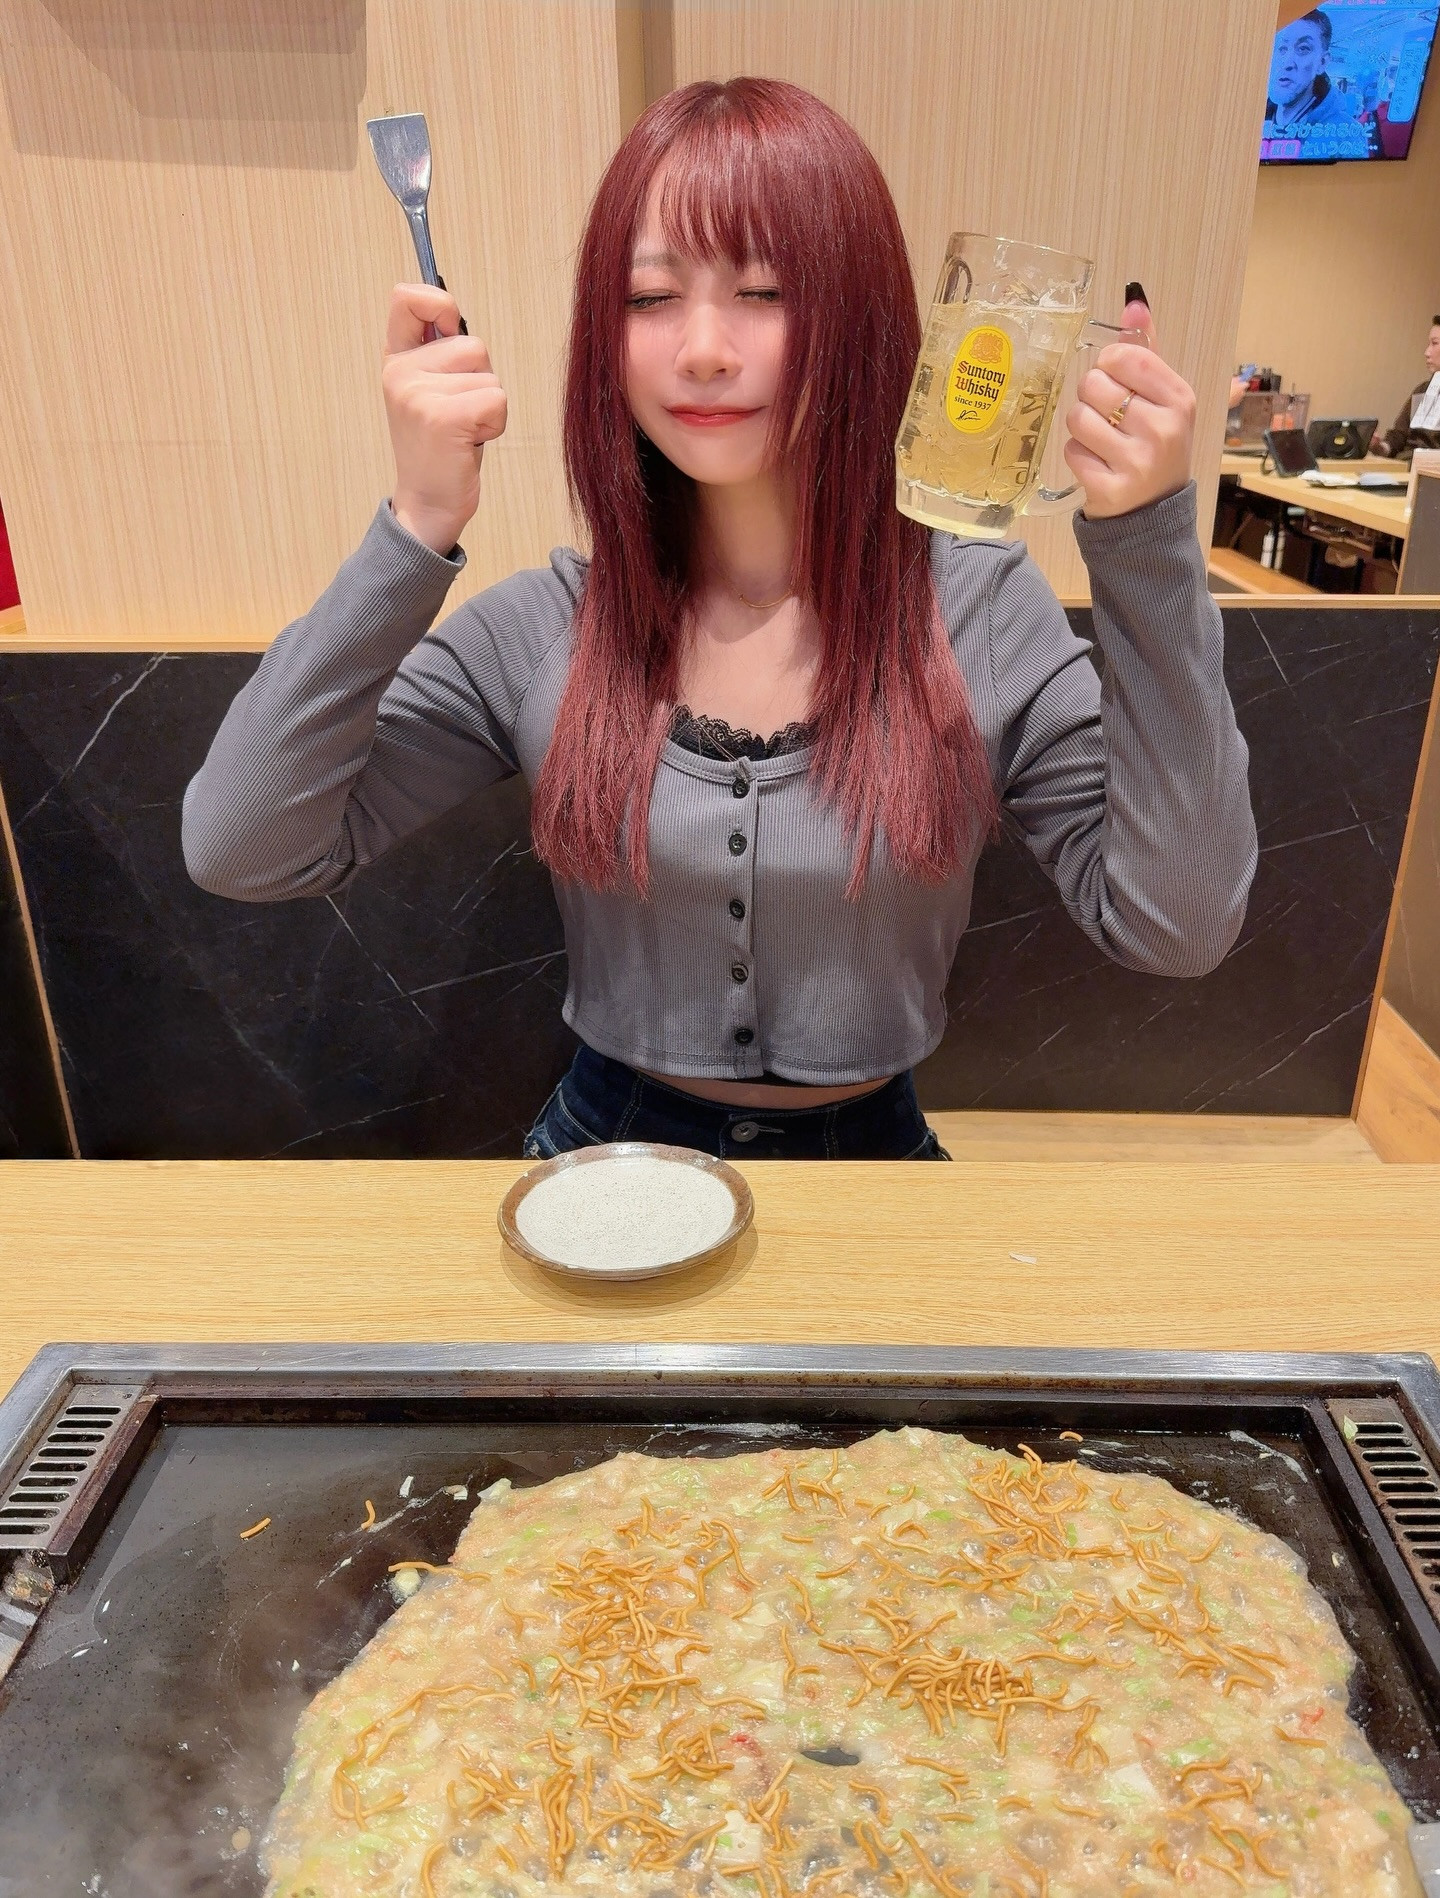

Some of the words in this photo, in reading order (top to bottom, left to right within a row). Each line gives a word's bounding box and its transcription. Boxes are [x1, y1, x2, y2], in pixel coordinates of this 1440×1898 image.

[957, 360, 1006, 387] Suntory
[954, 375, 1000, 402] Whisky
[954, 394, 973, 406] since
[974, 400, 992, 411] 1937
